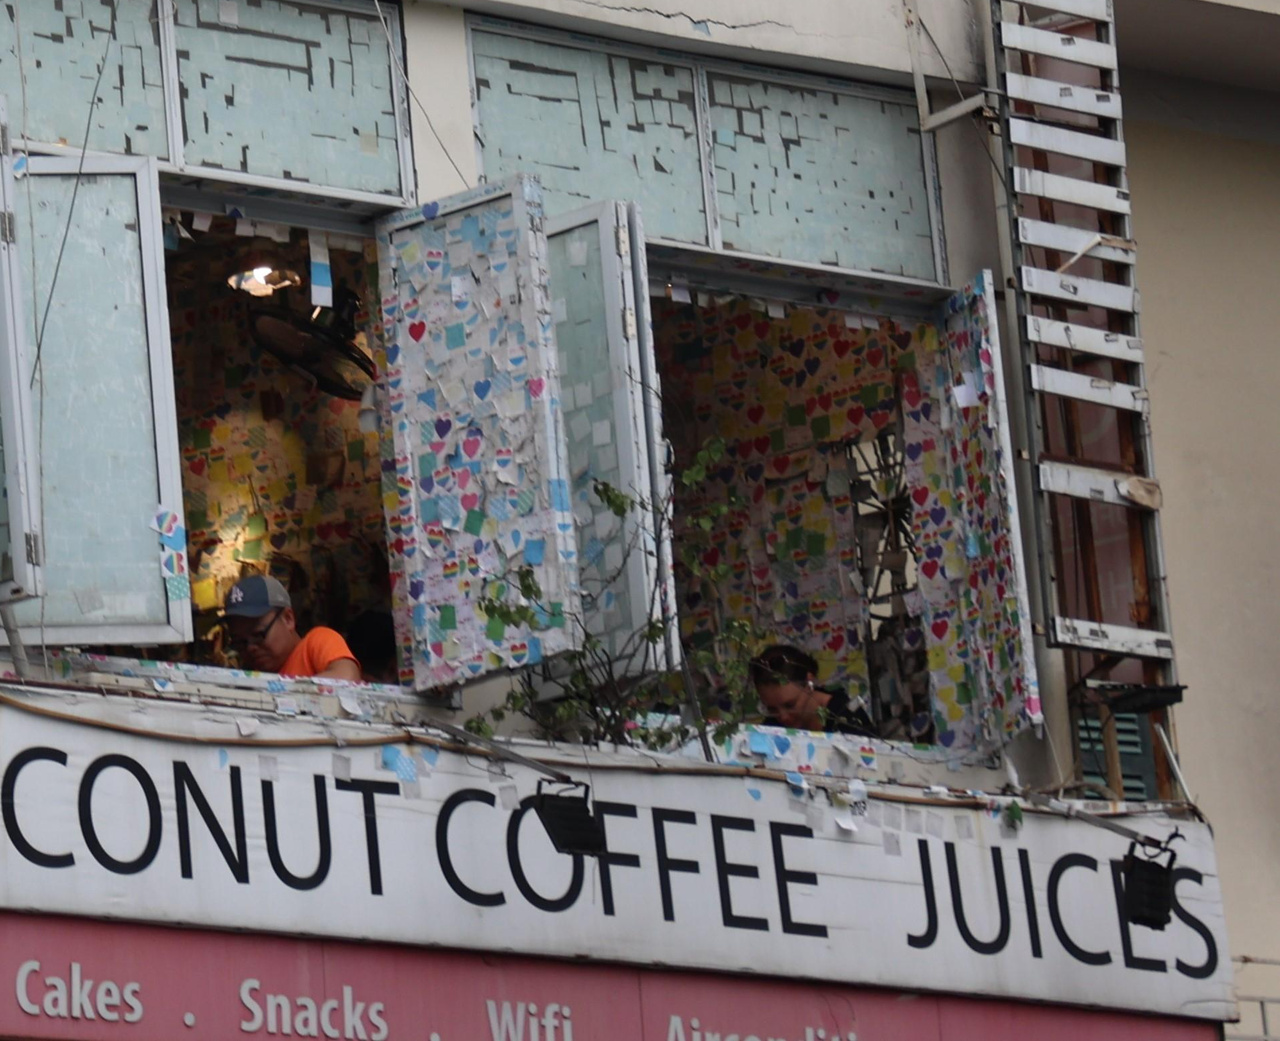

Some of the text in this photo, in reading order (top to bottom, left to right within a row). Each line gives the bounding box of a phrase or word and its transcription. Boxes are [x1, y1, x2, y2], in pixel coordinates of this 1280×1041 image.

[436, 788, 829, 938] COFFEE
[907, 838, 1218, 979] JUICES
[16, 960, 144, 1023] Cakes
[240, 978, 388, 1041] Snacks
[486, 999, 574, 1041] Wifi
